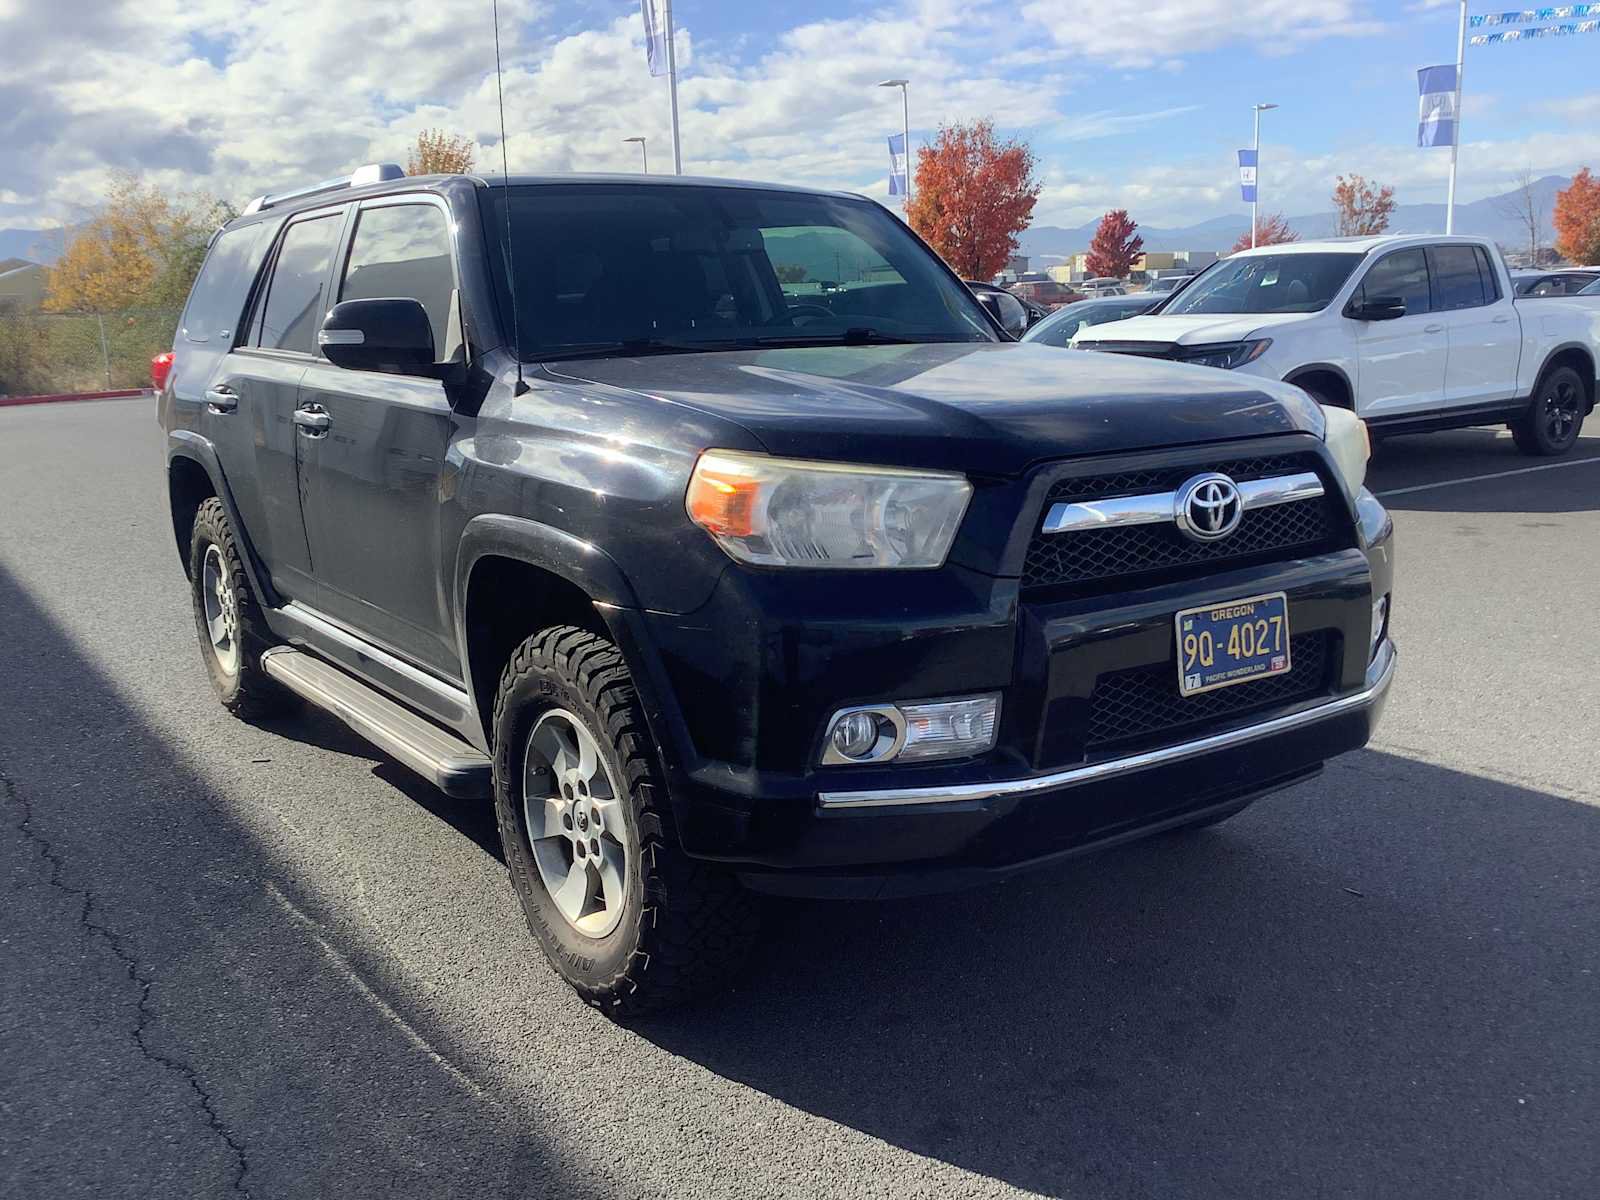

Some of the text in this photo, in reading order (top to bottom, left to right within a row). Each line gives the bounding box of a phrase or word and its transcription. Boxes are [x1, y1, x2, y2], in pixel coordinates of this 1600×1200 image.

[1211, 605, 1255, 621] OREGON
[1205, 664, 1266, 682] PACIFIC WONDERLAND
